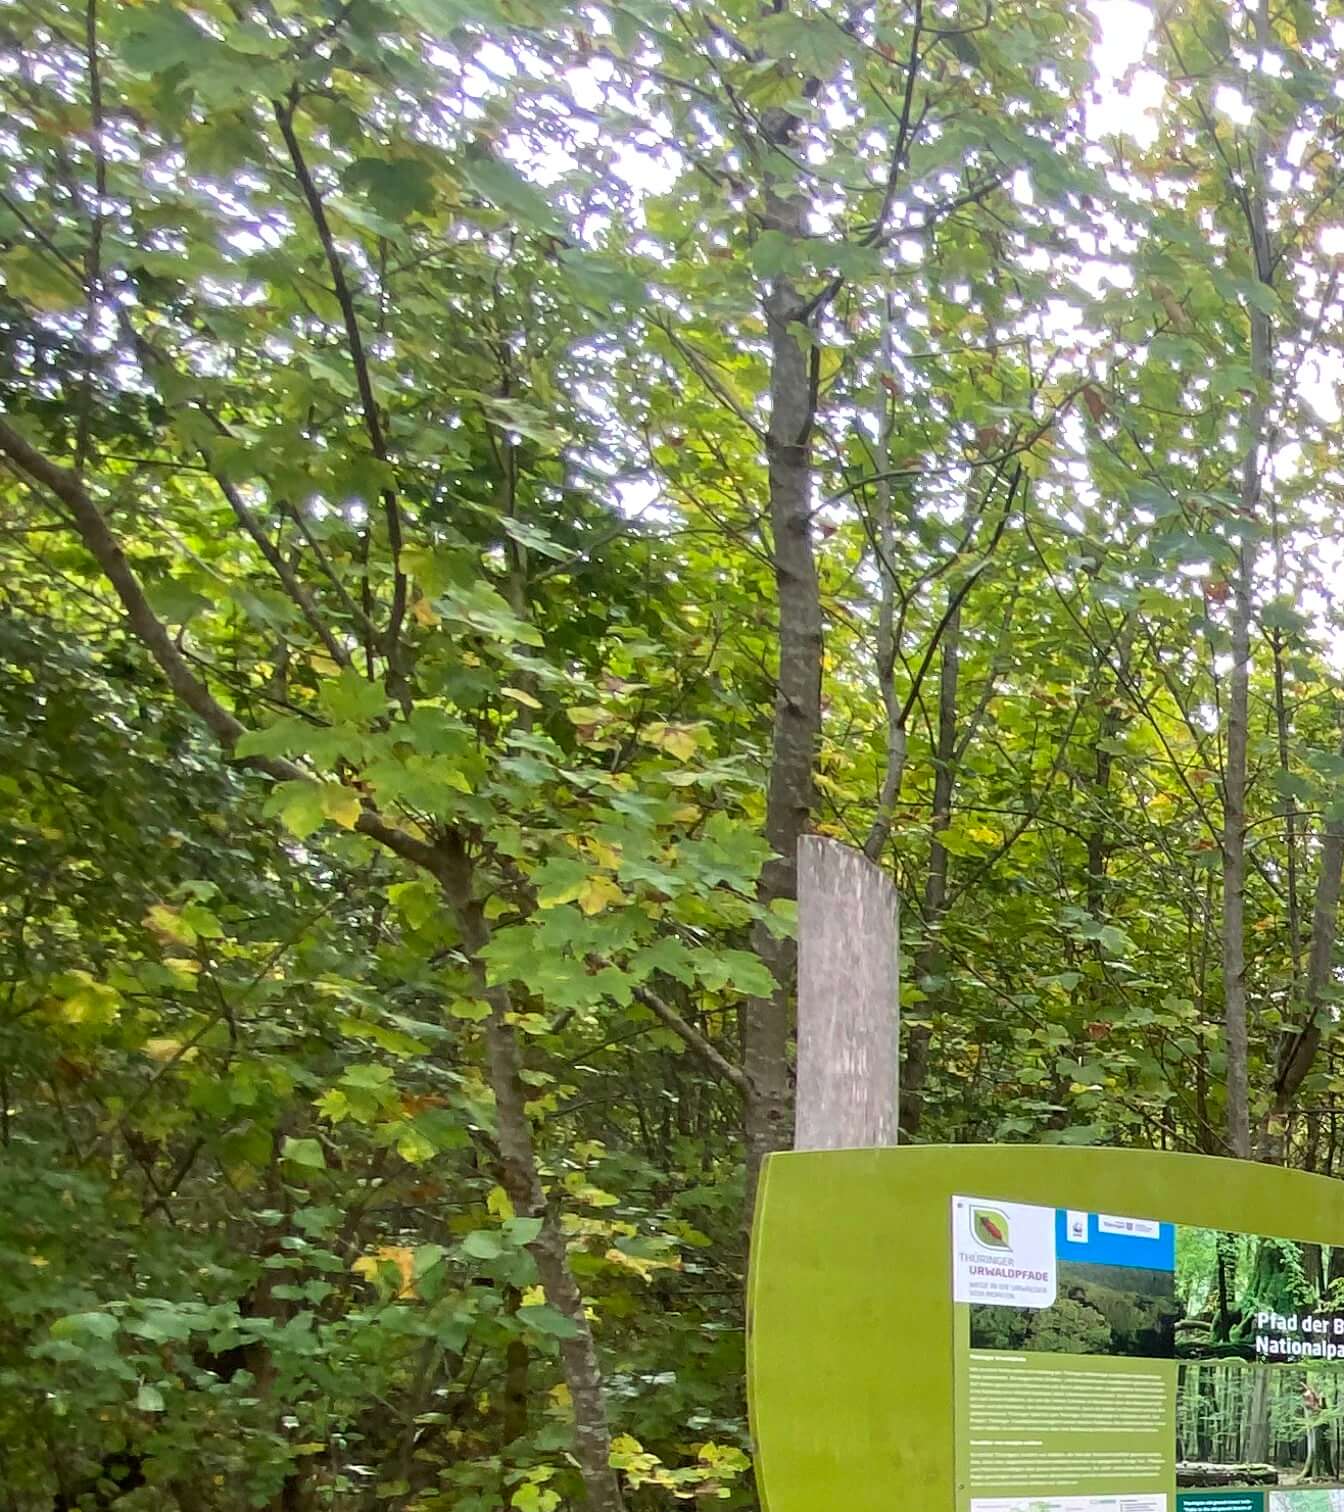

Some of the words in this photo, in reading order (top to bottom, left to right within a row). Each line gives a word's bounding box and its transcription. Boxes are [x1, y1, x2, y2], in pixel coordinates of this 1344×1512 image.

[969, 1265, 1049, 1282] URWALDPFADE
[1257, 1311, 1298, 1331] Pfad
[1301, 1315, 1330, 1333] der
